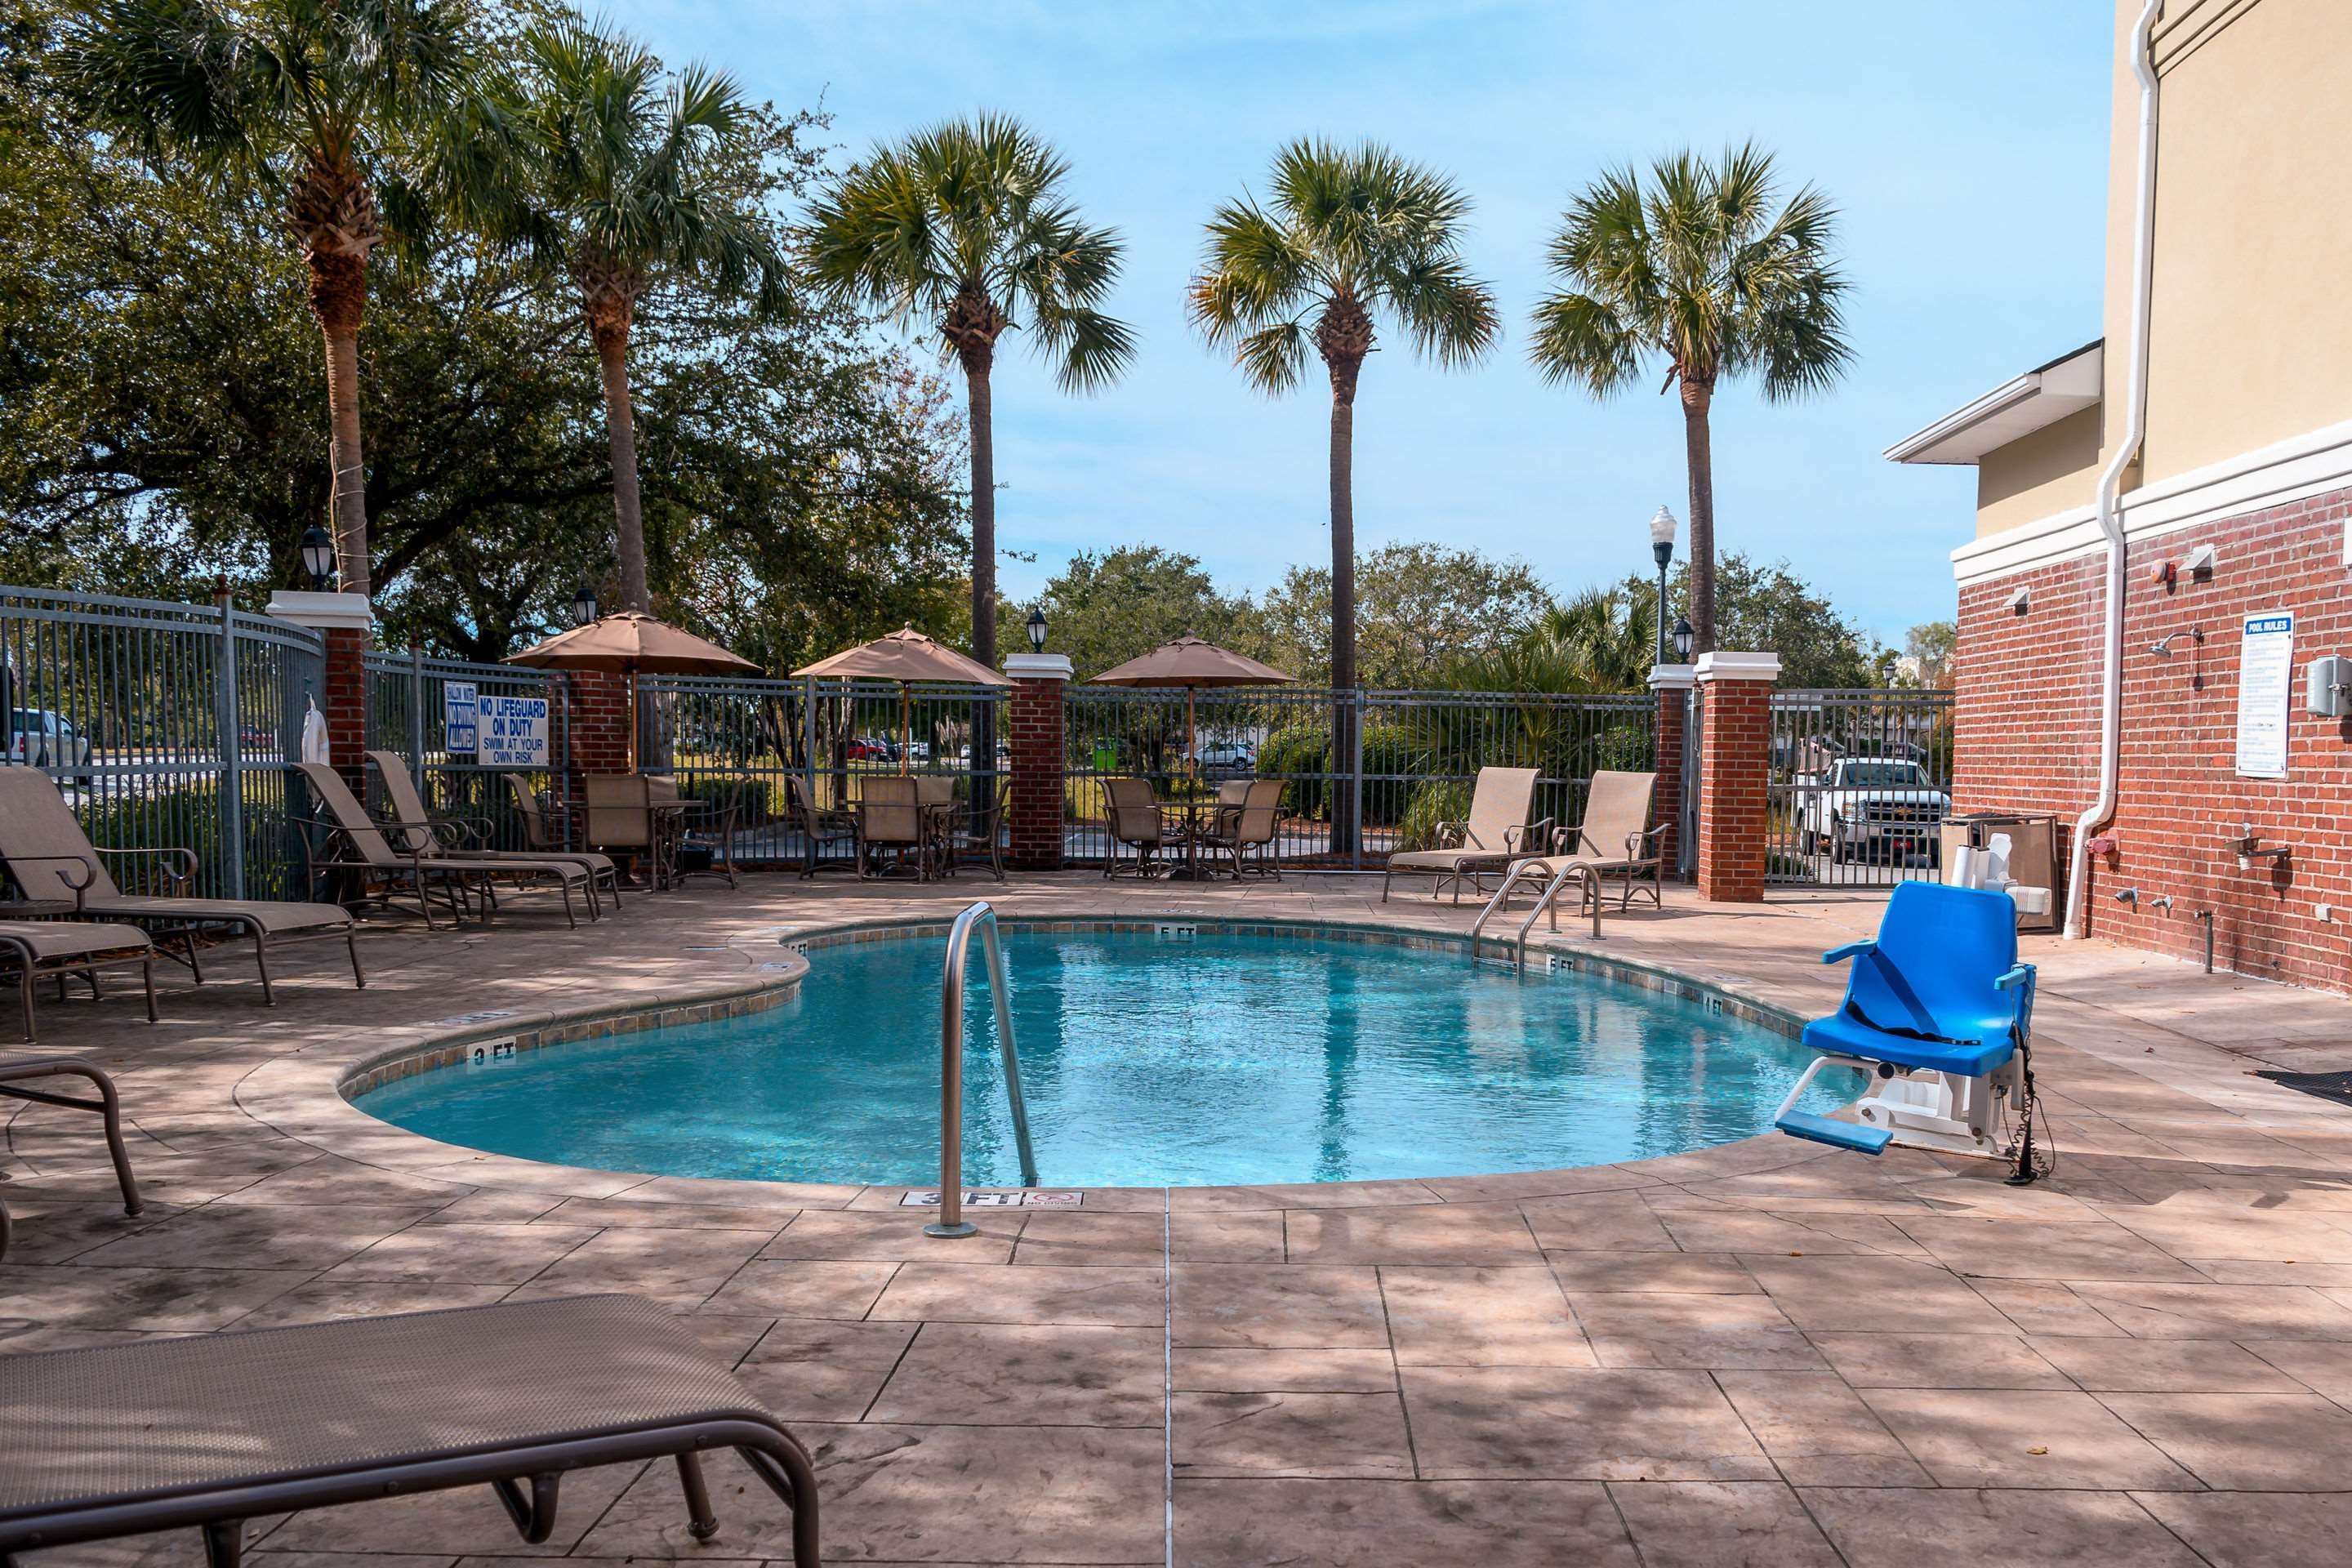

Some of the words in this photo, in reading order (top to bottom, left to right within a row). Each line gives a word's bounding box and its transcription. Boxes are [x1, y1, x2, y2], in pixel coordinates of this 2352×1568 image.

[2248, 622, 2262, 633] POOL
[2264, 620, 2287, 631] RULES
[480, 697, 492, 716] NO
[497, 699, 546, 719] LIFEGUARD
[493, 719, 505, 736] ON
[510, 719, 532, 736] DUTY
[483, 737, 504, 750] SWIM
[507, 738, 517, 750] AT
[521, 739, 543, 751] YOUR
[493, 751, 511, 764] OWN
[515, 751, 532, 764] RISK
[967, 1192, 1019, 1205] FT
